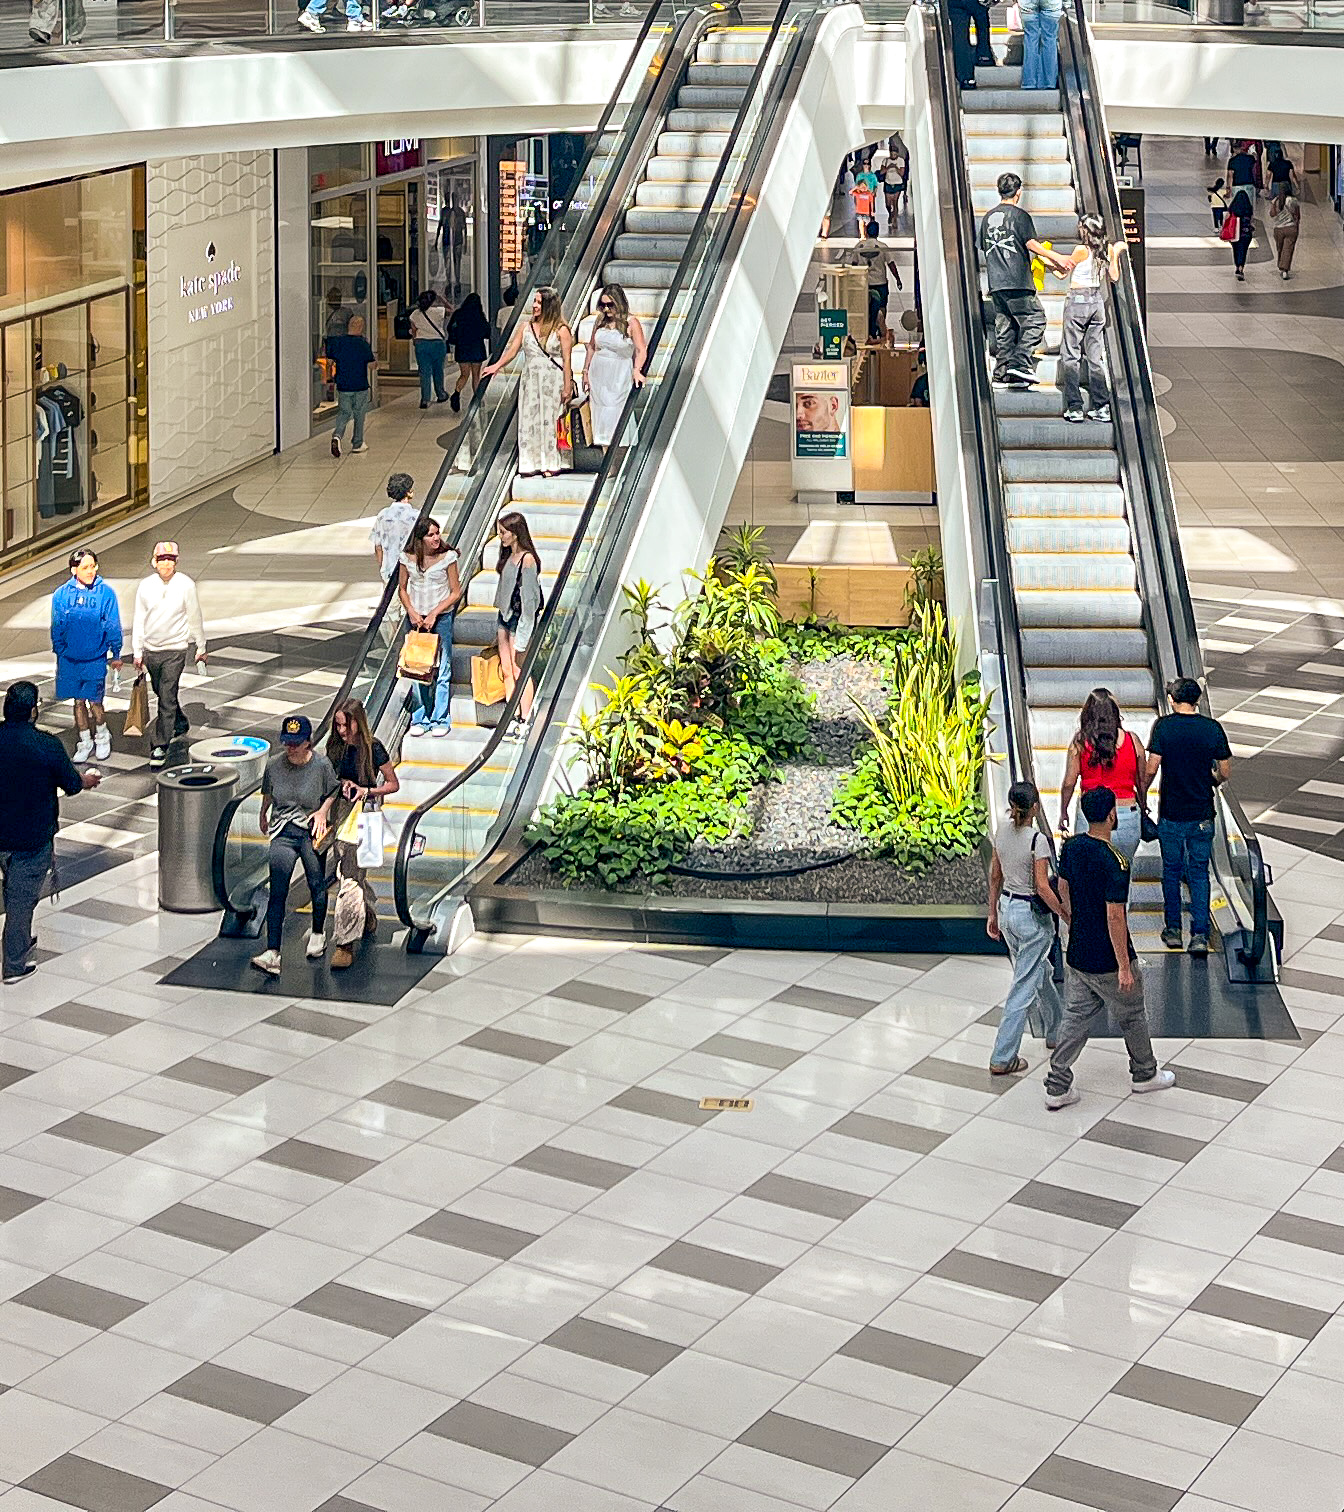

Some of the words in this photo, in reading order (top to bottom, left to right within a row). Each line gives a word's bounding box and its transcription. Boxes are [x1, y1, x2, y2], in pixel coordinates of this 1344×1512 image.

[180, 275, 207, 298] kate
[208, 259, 241, 296] spade
[188, 306, 208, 324] NEW
[210, 296, 235, 316] YORK
[801, 368, 839, 381] Banter
